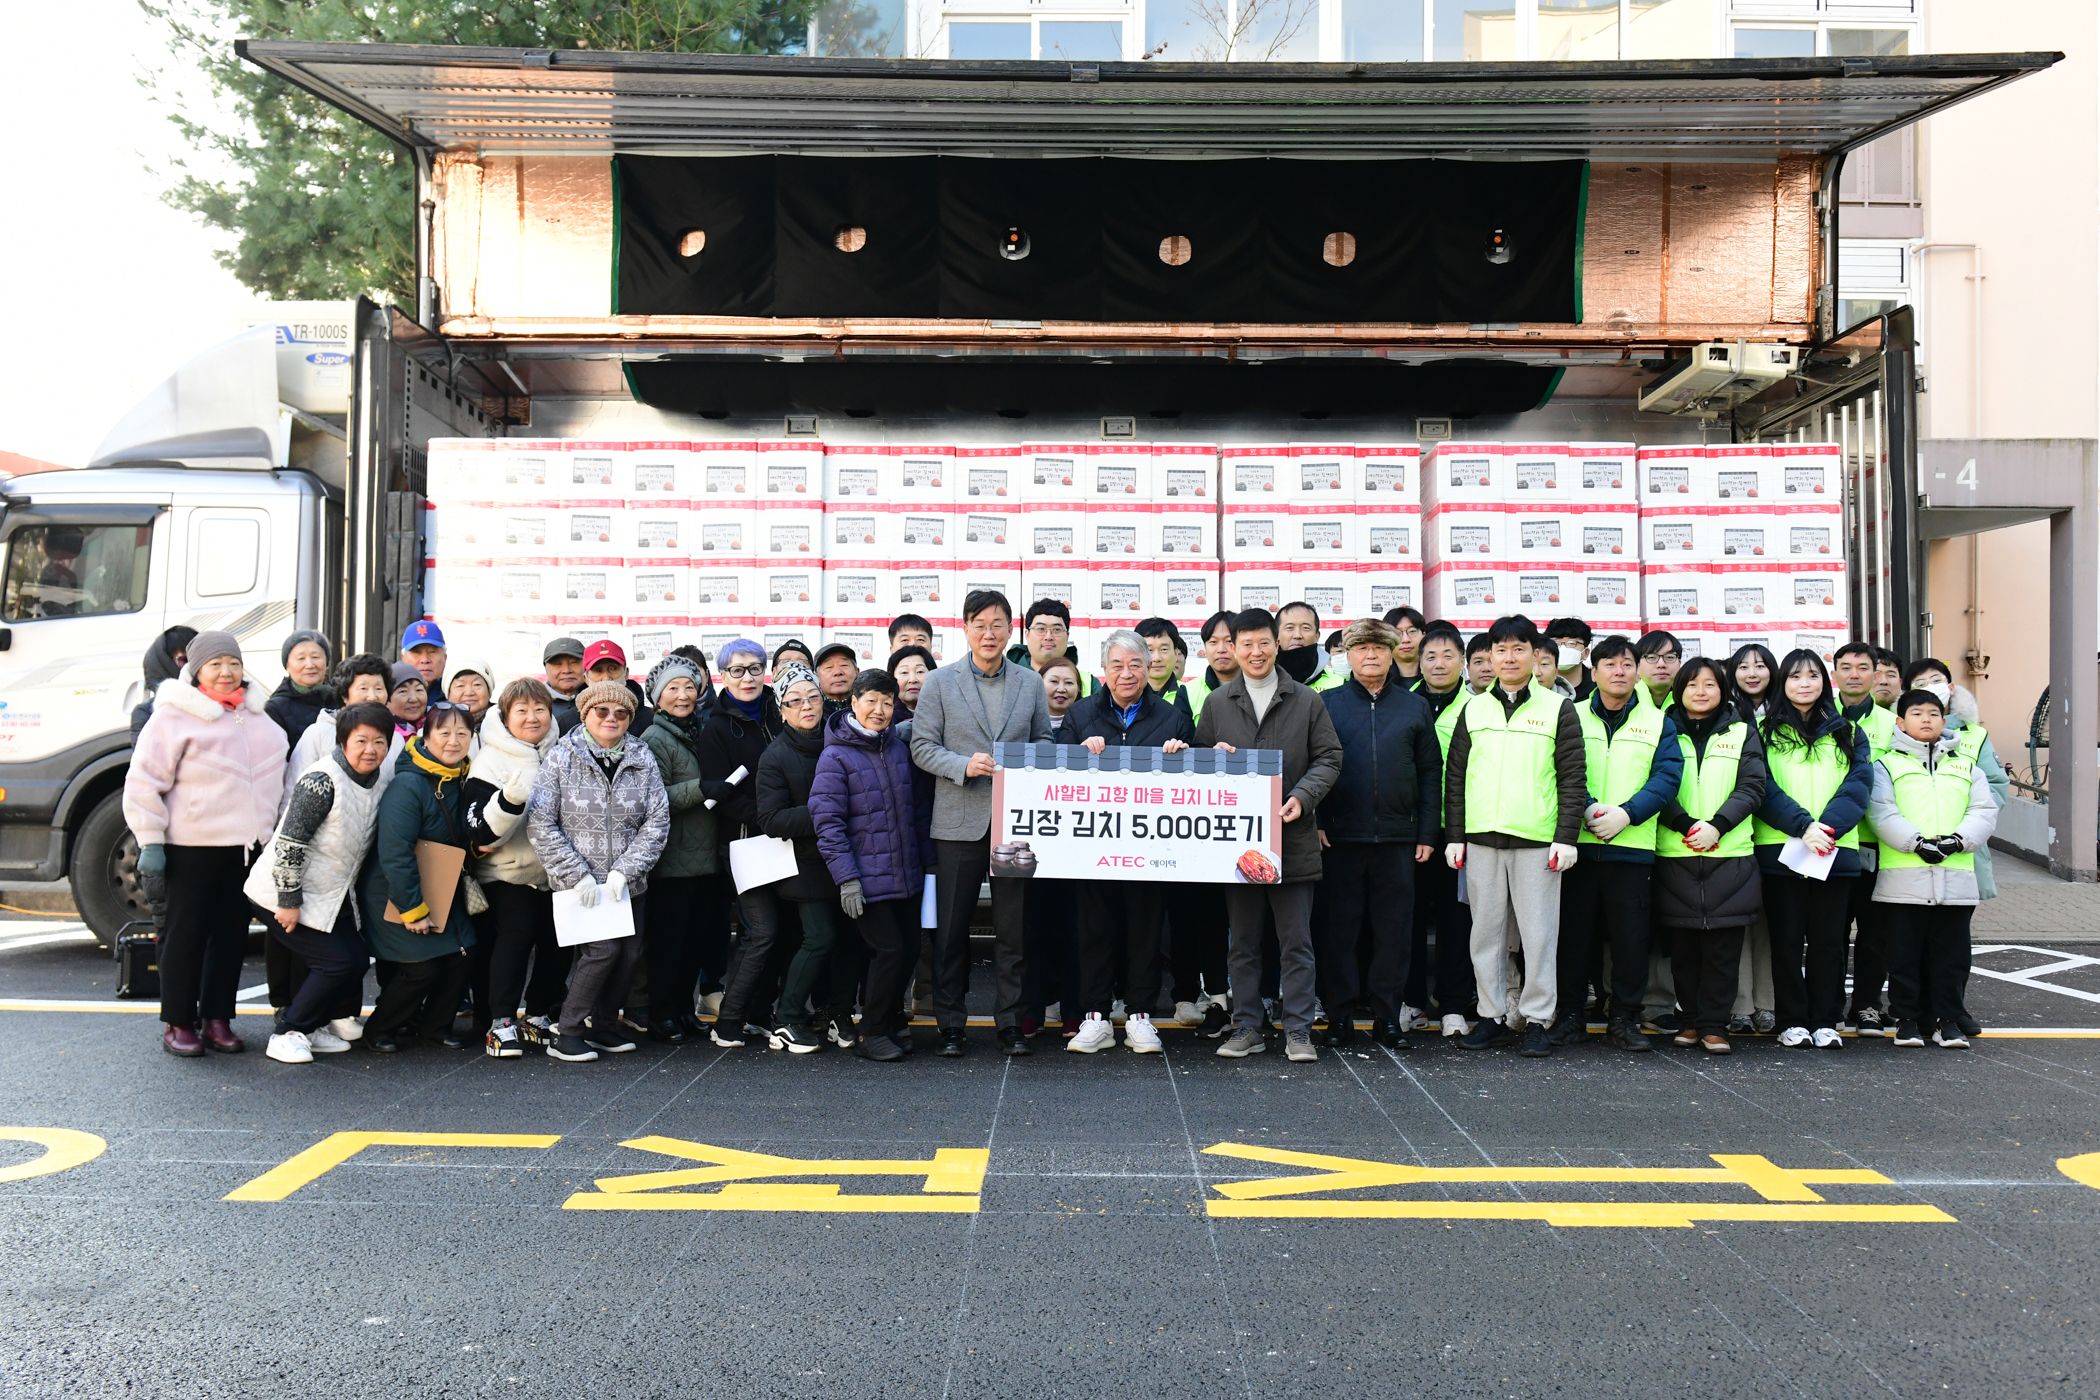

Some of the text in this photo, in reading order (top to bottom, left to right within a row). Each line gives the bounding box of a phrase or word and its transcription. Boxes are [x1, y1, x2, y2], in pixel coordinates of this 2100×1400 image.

[293, 324, 348, 339] TR-1000S
[314, 353, 346, 365] Super
[1045, 784, 1238, 806] 사할린 고향 마을 김치 나눔
[1010, 809, 1061, 836] 김장
[1072, 810, 1121, 838] 김치
[1096, 856, 1177, 868] ATEC 에이텍
